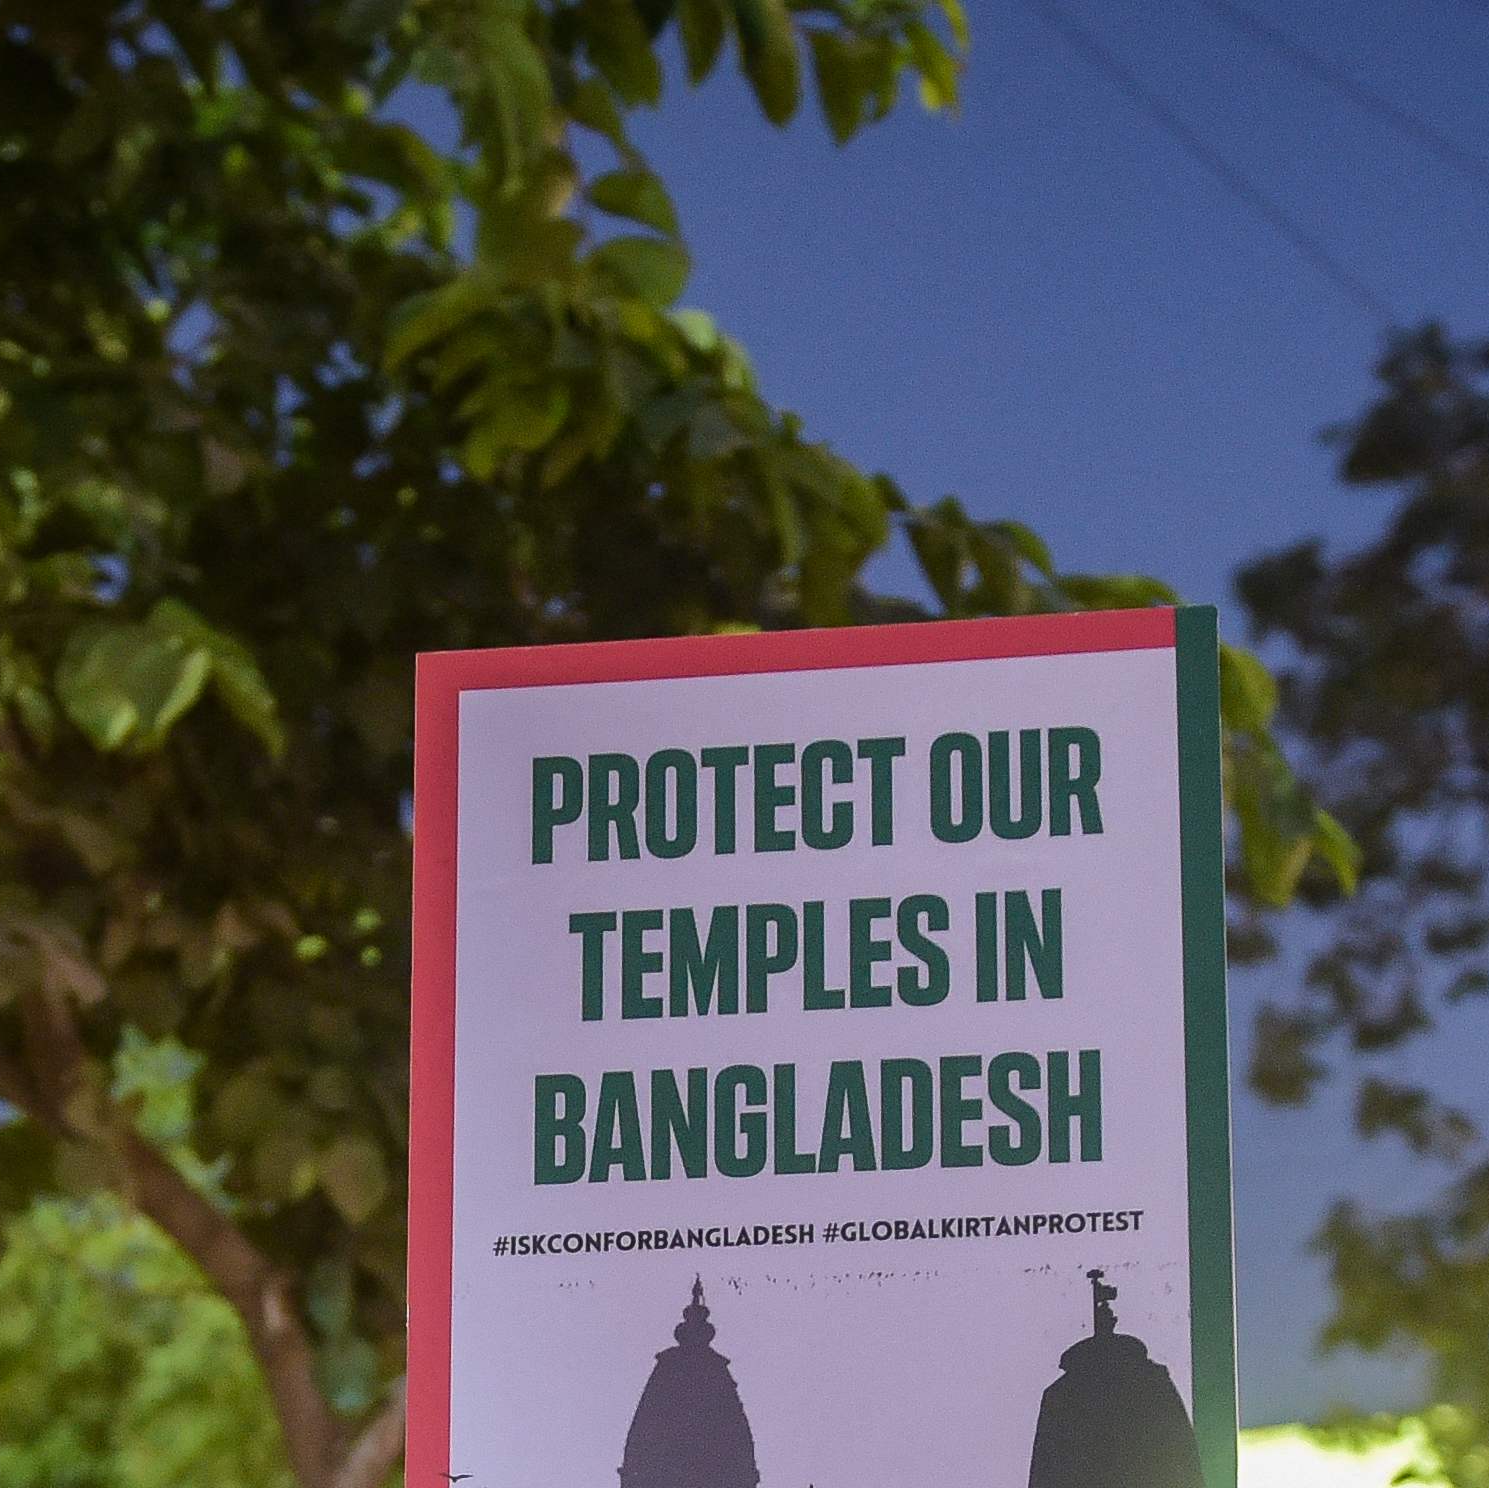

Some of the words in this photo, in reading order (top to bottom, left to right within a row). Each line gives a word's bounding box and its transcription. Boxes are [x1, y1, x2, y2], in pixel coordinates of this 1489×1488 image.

[531, 736, 906, 865] PROTECT
[929, 726, 1104, 844] OUR
[568, 894, 951, 1022] TEMPLES
[974, 887, 1064, 1004] IN
[533, 1048, 1103, 1187] BANGLADESH
[492, 1223, 815, 1257] #ISKCONFORBANGLADESH
[822, 1210, 1145, 1244] #GLOBALKIRTANPROTEST
